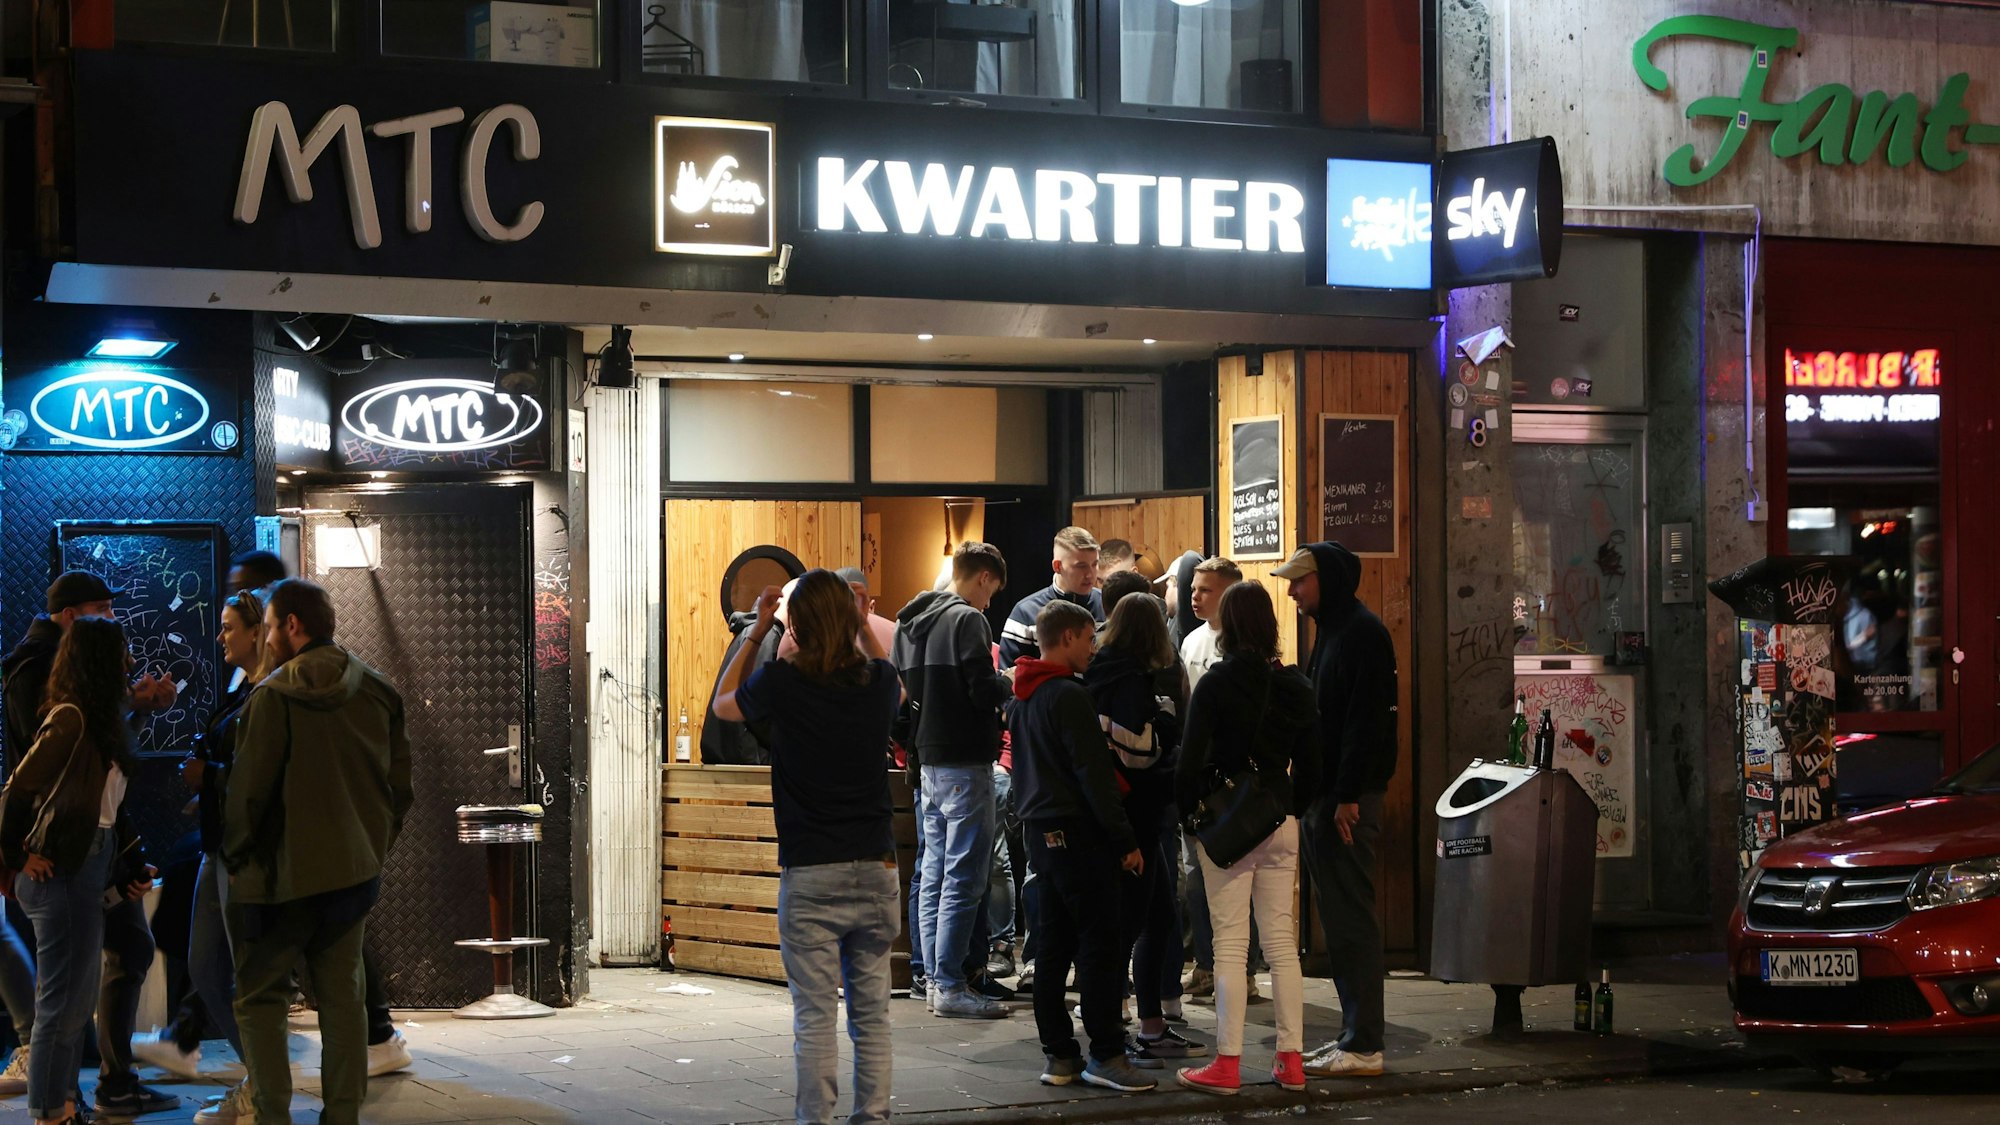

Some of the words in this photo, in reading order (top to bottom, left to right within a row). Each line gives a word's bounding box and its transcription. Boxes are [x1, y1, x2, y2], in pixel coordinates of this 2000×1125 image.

[233, 101, 545, 249] MTC
[817, 156, 1305, 255] KWARTIER
[1447, 177, 1526, 249] sky
[70, 384, 170, 438] MTC
[391, 391, 485, 444] MTC
[1470, 419, 1487, 447] 8
[571, 430, 582, 463] 10
[1234, 491, 1257, 510] KÖLSCH
[1324, 483, 1367, 498] MEXIKANER
[1324, 513, 1360, 527] TEQUILA
[1854, 674, 1913, 685] Kartenzahlung
[1863, 687, 1874, 696] ab
[1876, 686, 1897, 696] 20,00
[1898, 686, 1905, 695] €
[1446, 840, 1457, 848] LOVE
[1457, 837, 1487, 846] FOOTBALL
[1461, 846, 1484, 854] RACISM
[1770, 954, 1780, 977] K
[1789, 954, 1811, 977] MN
[1813, 953, 1854, 977] 1230
